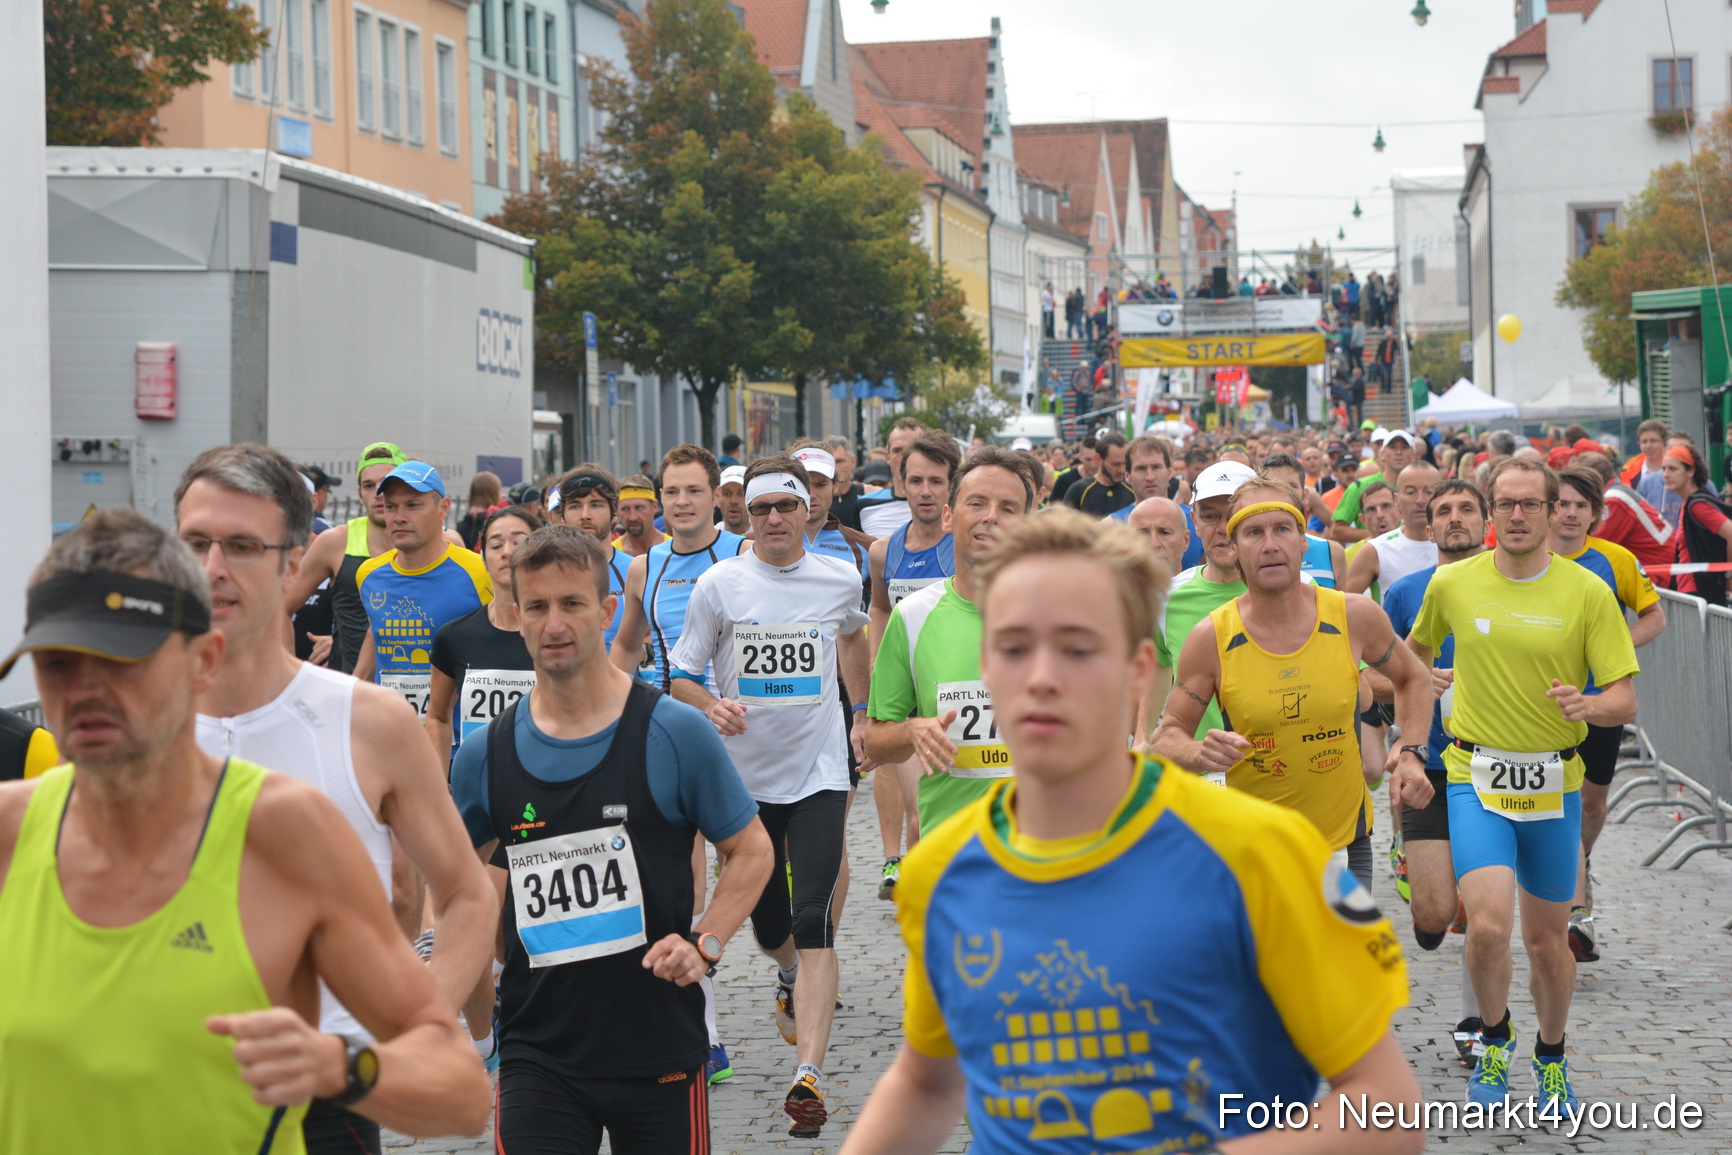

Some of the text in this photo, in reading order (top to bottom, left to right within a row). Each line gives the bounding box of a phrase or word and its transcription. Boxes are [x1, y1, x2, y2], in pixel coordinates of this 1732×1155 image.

[477, 308, 522, 378] BOCK
[1186, 341, 1258, 360] START
[735, 631, 807, 641] PARTL Neumarkt
[742, 642, 816, 675] 2389
[466, 677, 536, 687] PARTL Neumarkt
[765, 682, 794, 695] Hans
[939, 691, 974, 702] PARTL
[1251, 737, 1276, 749] Seidl
[982, 750, 1009, 765] Udo
[1309, 748, 1344, 764] PIZZERIA
[1317, 756, 1341, 769] ELIO
[1490, 761, 1546, 790] 203
[1501, 797, 1535, 811] Ulrich
[511, 842, 607, 869] PARTL Neumarkt
[523, 858, 628, 919] 3404
[658, 1072, 687, 1084] adidas
